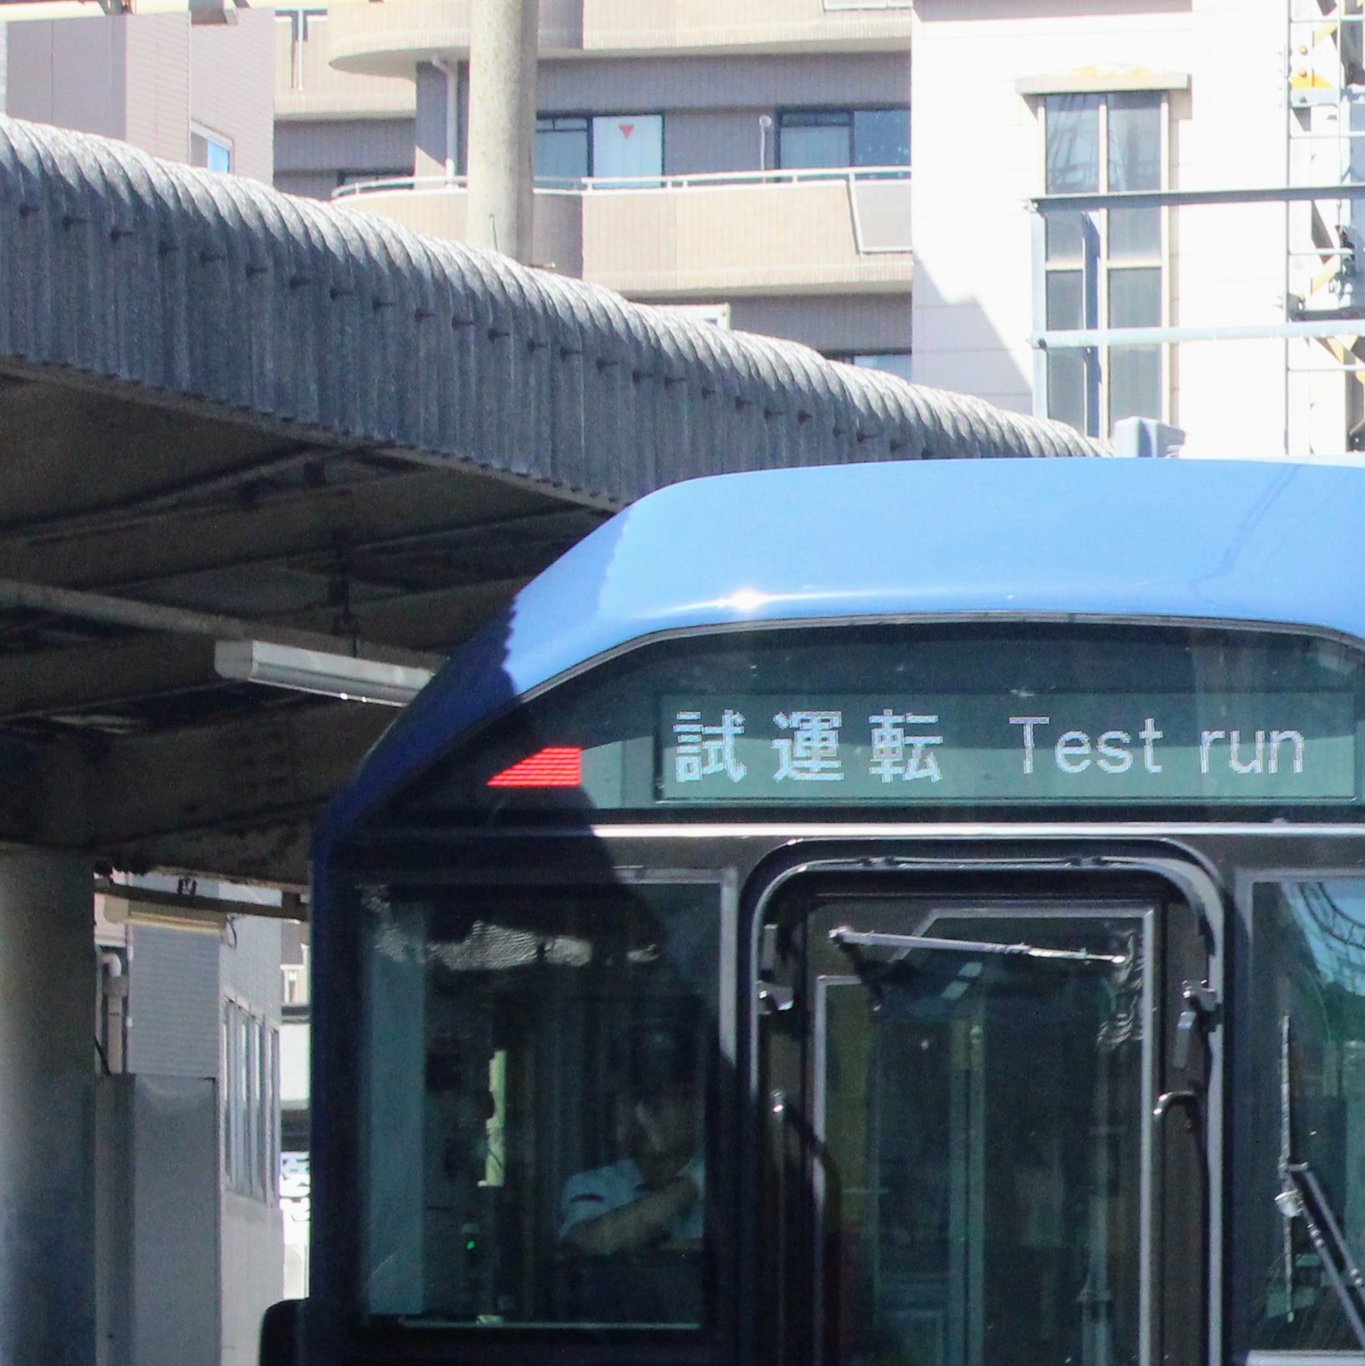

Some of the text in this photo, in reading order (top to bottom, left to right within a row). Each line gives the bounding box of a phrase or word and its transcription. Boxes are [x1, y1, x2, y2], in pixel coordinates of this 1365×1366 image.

[673, 708, 944, 783] 試運転
[1008, 716, 1305, 775] Test run
